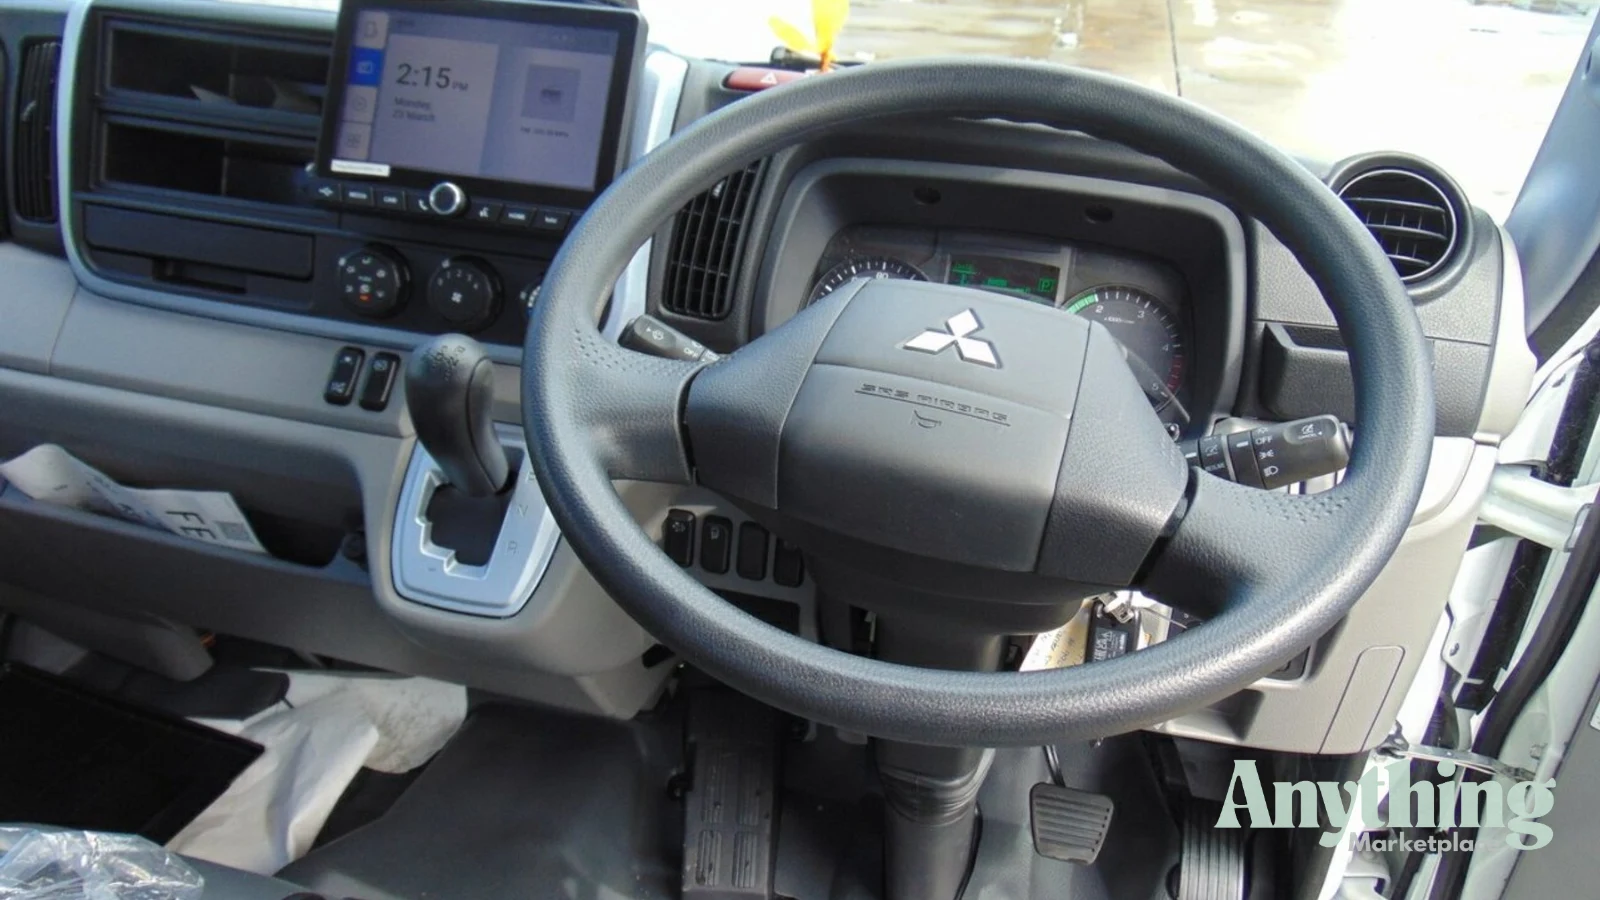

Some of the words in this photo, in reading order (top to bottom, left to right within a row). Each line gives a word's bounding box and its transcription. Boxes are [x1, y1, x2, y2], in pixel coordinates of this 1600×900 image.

[396, 62, 451, 89] 2:15
[1095, 304, 1104, 314] 2
[1136, 309, 1145, 319] 3
[1161, 343, 1169, 352] 4
[859, 382, 910, 399] SRS
[916, 393, 1008, 422] AIRBAG
[1255, 435, 1273, 446] OFF
